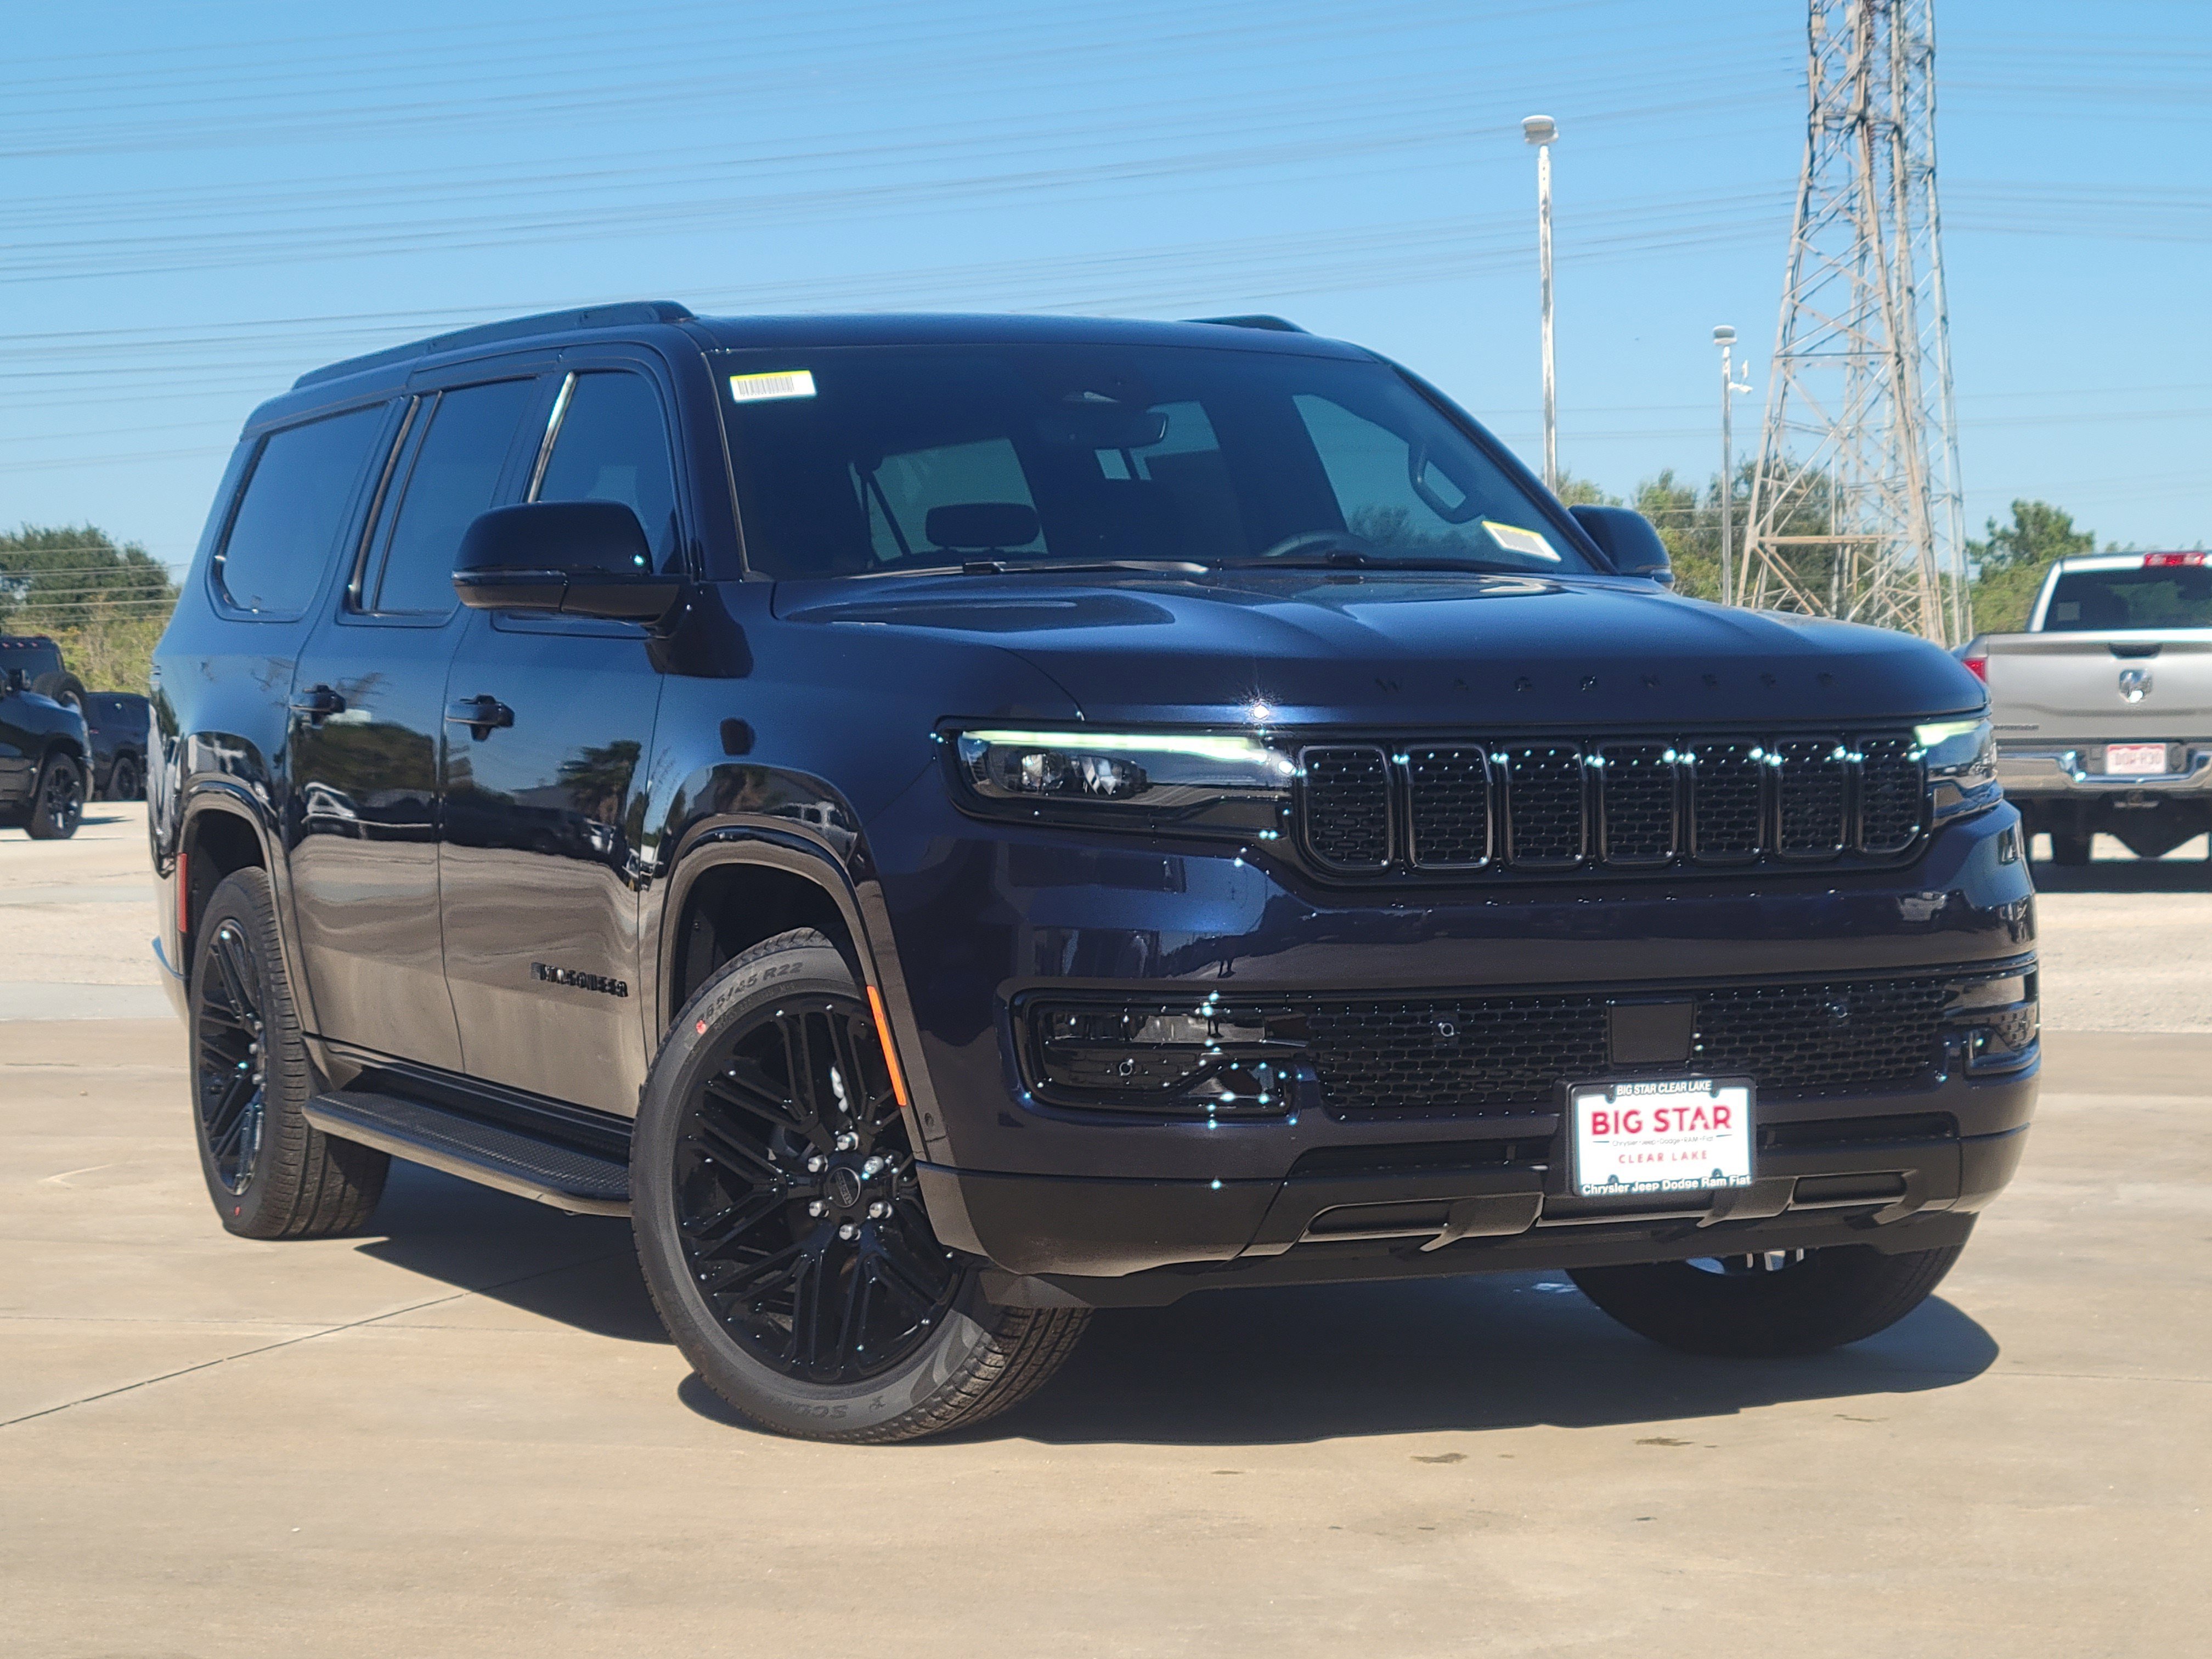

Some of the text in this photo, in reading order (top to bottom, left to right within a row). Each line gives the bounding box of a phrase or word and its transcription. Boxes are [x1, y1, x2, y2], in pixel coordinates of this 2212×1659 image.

[1374, 671, 1837, 692] WAGON
[763, 962, 803, 980] R22
[1617, 1080, 1712, 1096] BIG STAR CLEAR LAKE
[1591, 1105, 1732, 1136] BIG STAR
[1618, 1150, 1708, 1164] CLEAR LAKE
[1582, 1173, 1752, 1195] Chrysler Jeep Dodge Ram Fiat
